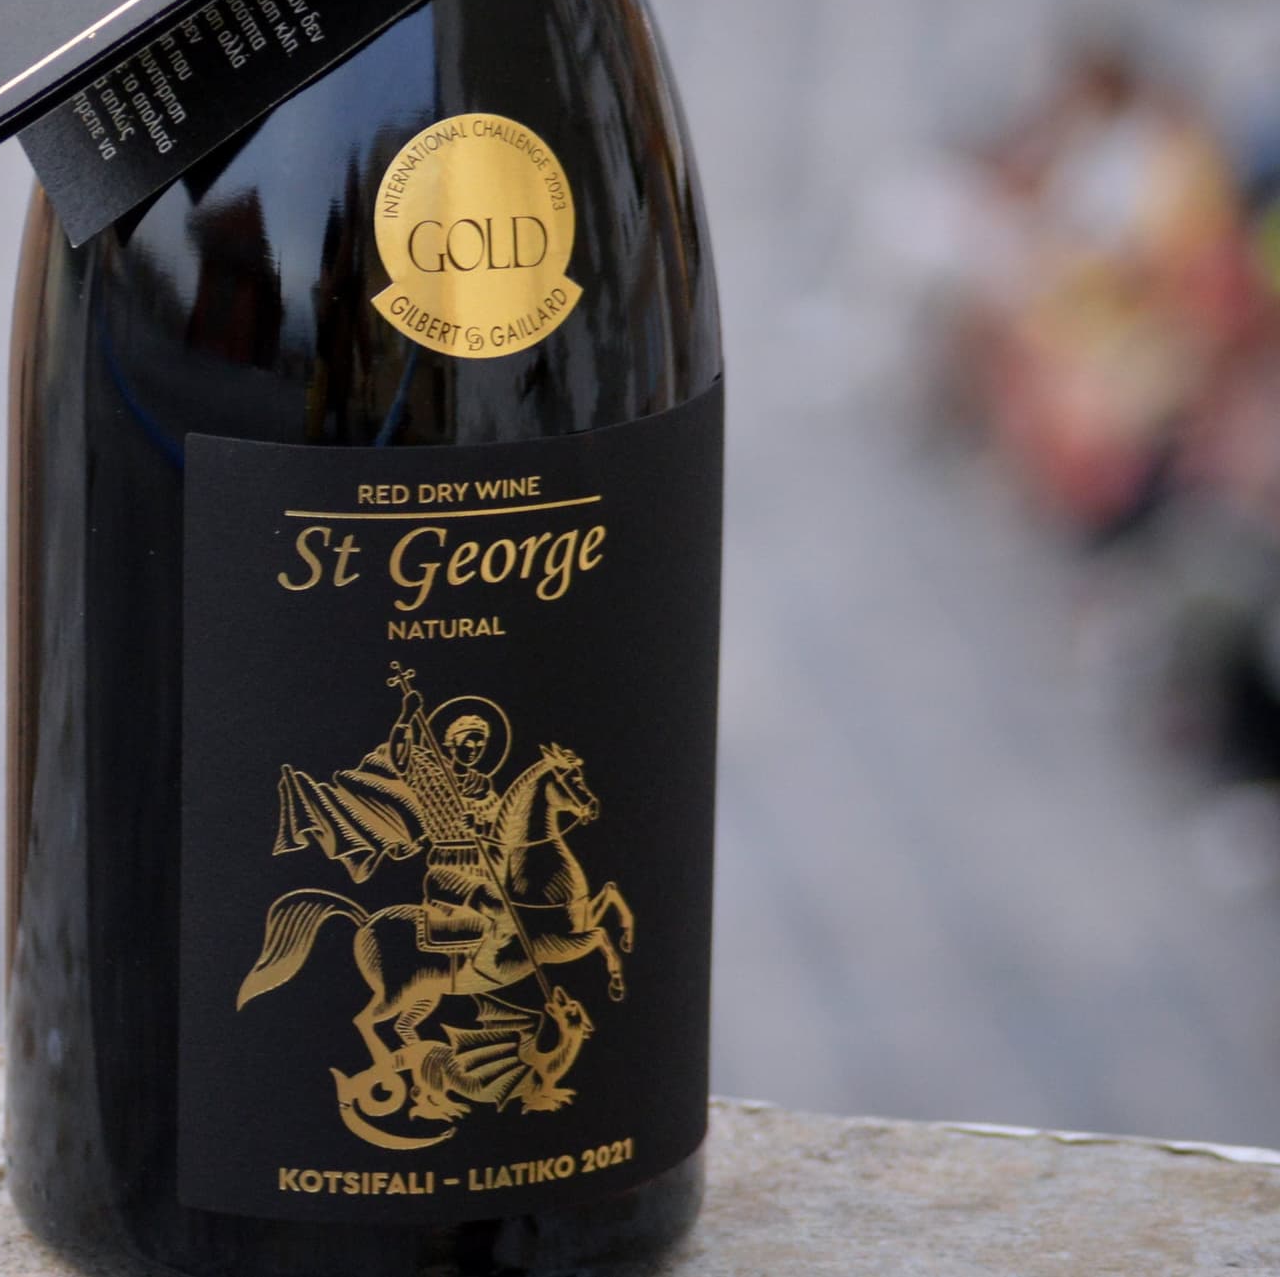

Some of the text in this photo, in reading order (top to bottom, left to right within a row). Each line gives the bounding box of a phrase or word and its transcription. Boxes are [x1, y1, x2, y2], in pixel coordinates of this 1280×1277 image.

[300, 12, 325, 43] δεν
[383, 120, 568, 219] INTERNATIONAL CHALLENGE 2023
[408, 216, 548, 273] GOLD
[390, 296, 462, 346] GILBERT
[490, 288, 568, 348] GAILLARD
[357, 476, 542, 505] RED DRY WINE
[277, 524, 607, 611] St George
[387, 616, 506, 641] NATURAL
[278, 1167, 435, 1196] KOTSIFALI
[467, 1154, 573, 1191] LIATIKO
[580, 1137, 634, 1175] 2021
